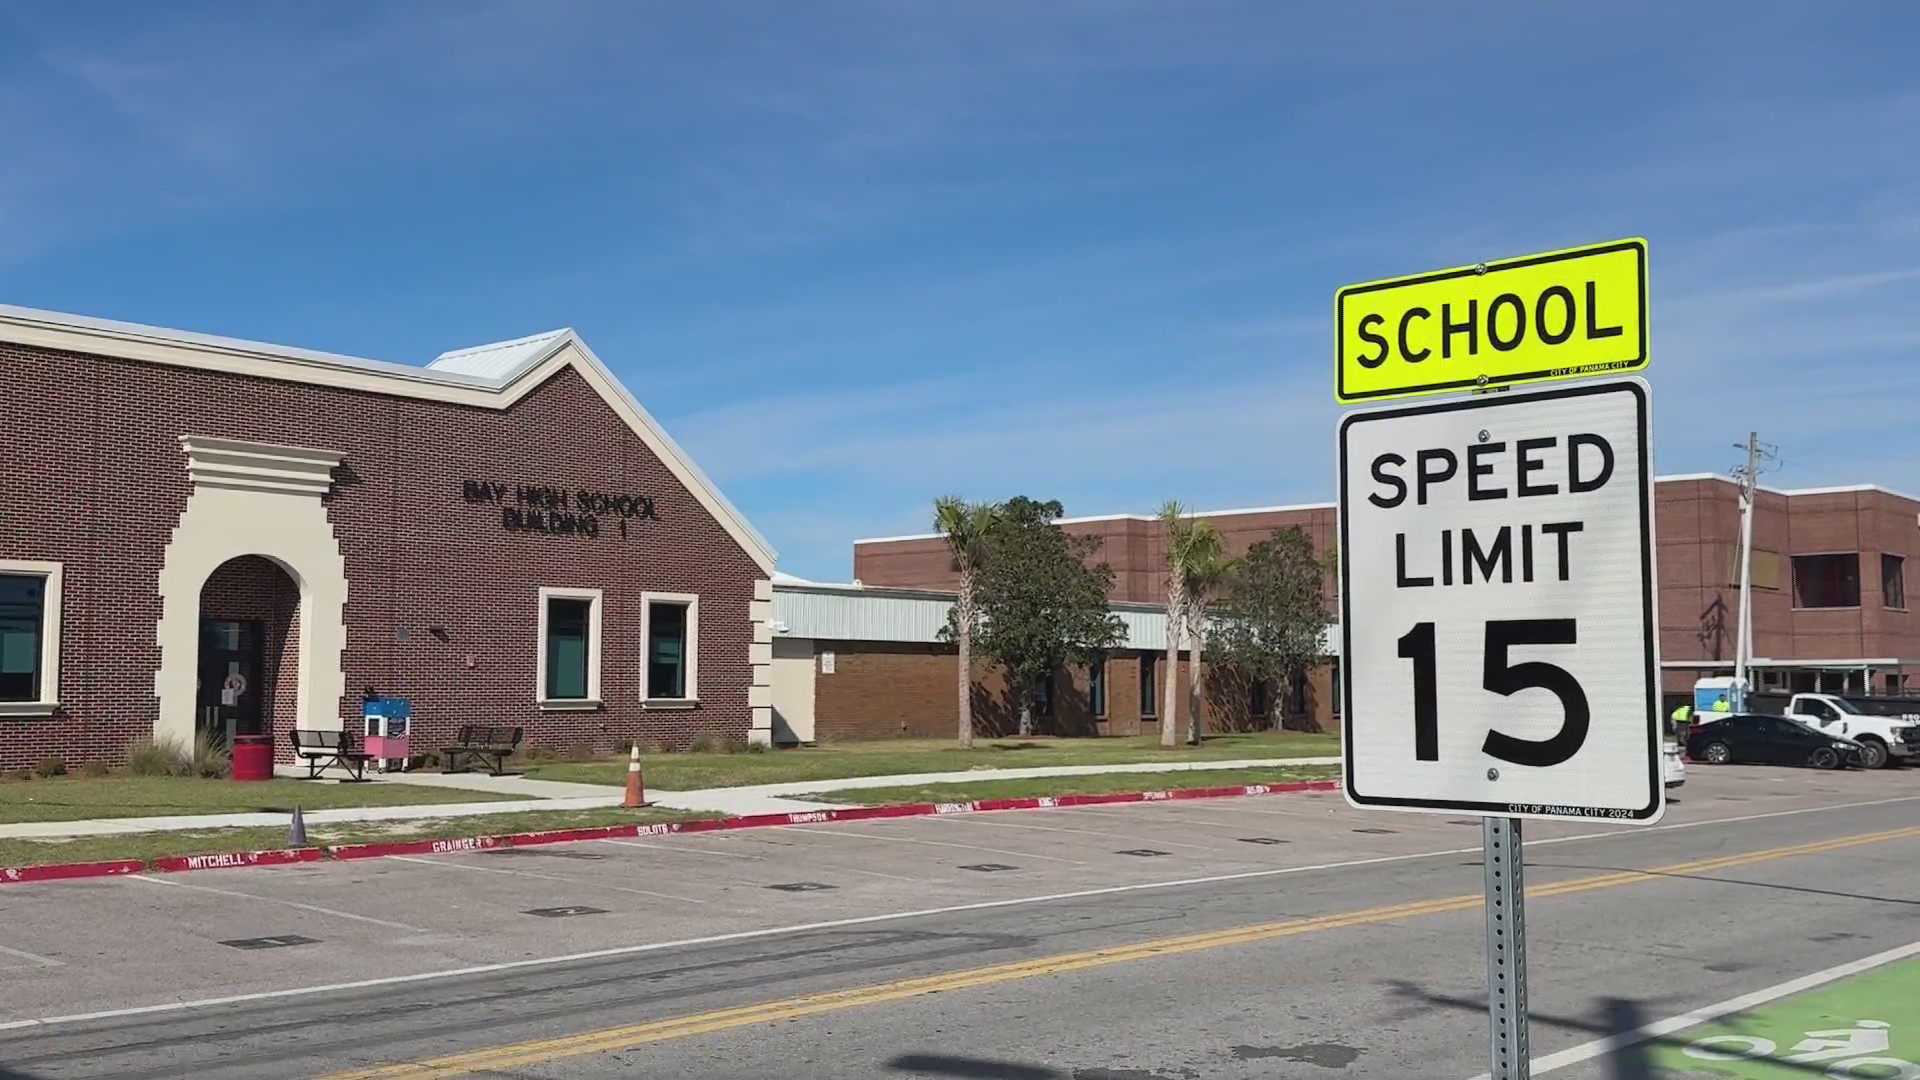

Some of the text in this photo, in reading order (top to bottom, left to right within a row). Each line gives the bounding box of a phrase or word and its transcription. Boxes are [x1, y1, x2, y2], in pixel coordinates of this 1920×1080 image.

[1356, 281, 1624, 369] SCHOOL
[1549, 360, 1629, 377] CITY OF PANAMA CITY
[1368, 432, 1615, 509] SPEED
[463, 479, 503, 502] BAY
[577, 490, 658, 520] SCHOOL
[1396, 521, 1584, 588] LIMIT
[1397, 618, 1591, 767] 15
[1508, 803, 1634, 819] CITY OF PANAMA CITY 2024
[187, 853, 245, 868] MITCHELL
[432, 838, 482, 853] GRAINGER
